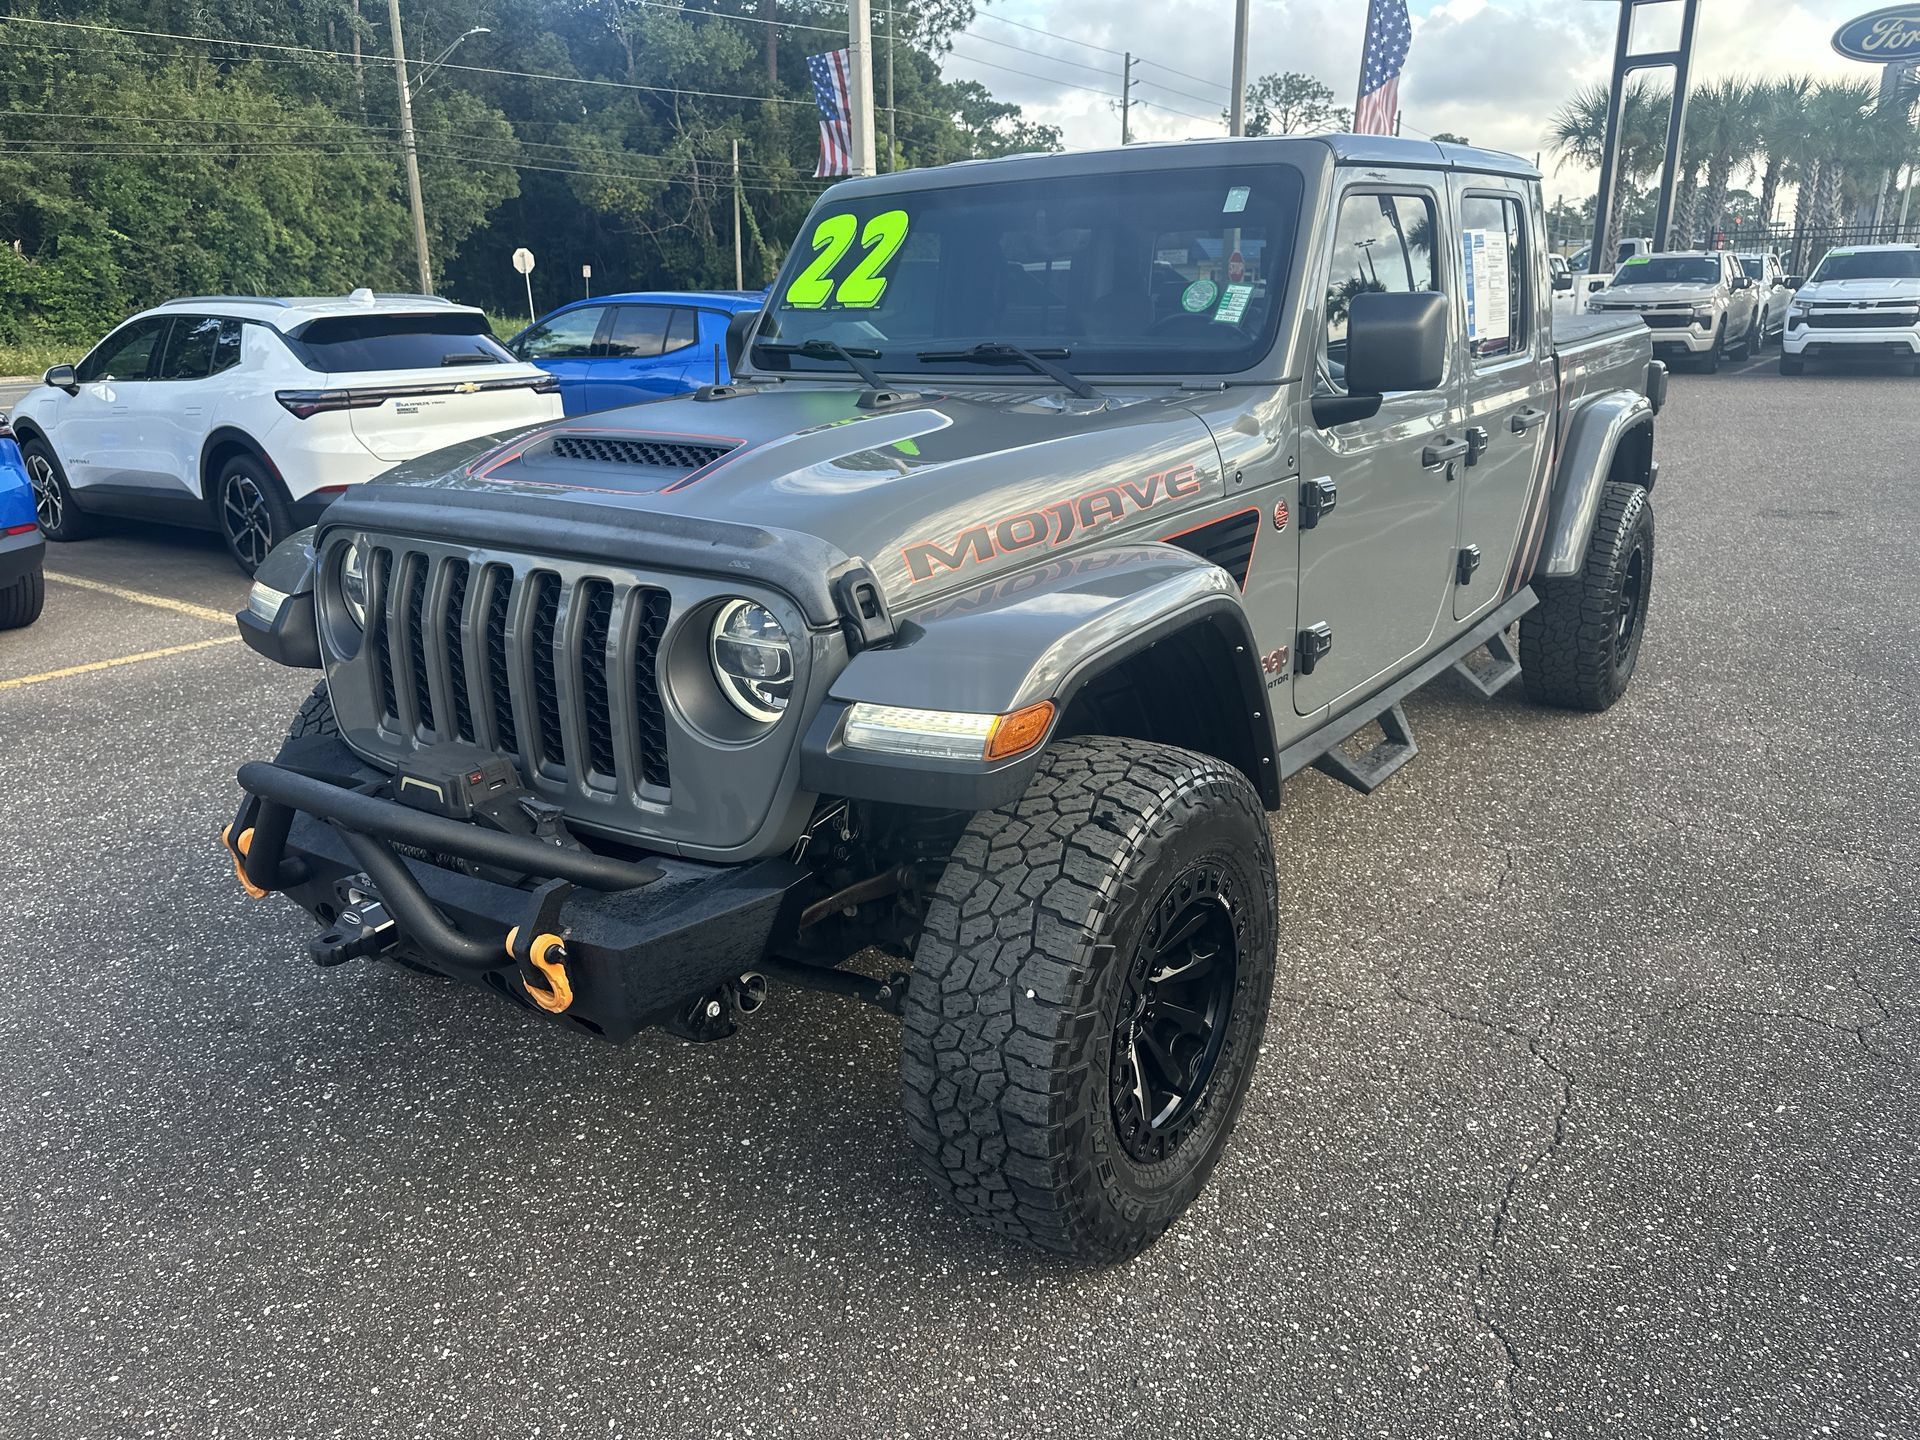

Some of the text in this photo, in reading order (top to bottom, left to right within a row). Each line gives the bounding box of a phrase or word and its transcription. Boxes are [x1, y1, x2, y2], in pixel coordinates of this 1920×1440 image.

[1861, 16, 1920, 51] For
[786, 209, 910, 309] 22
[900, 464, 1201, 584] MOJAVE
[1260, 645, 1290, 676] eep
[1267, 673, 1290, 690] ATOR
